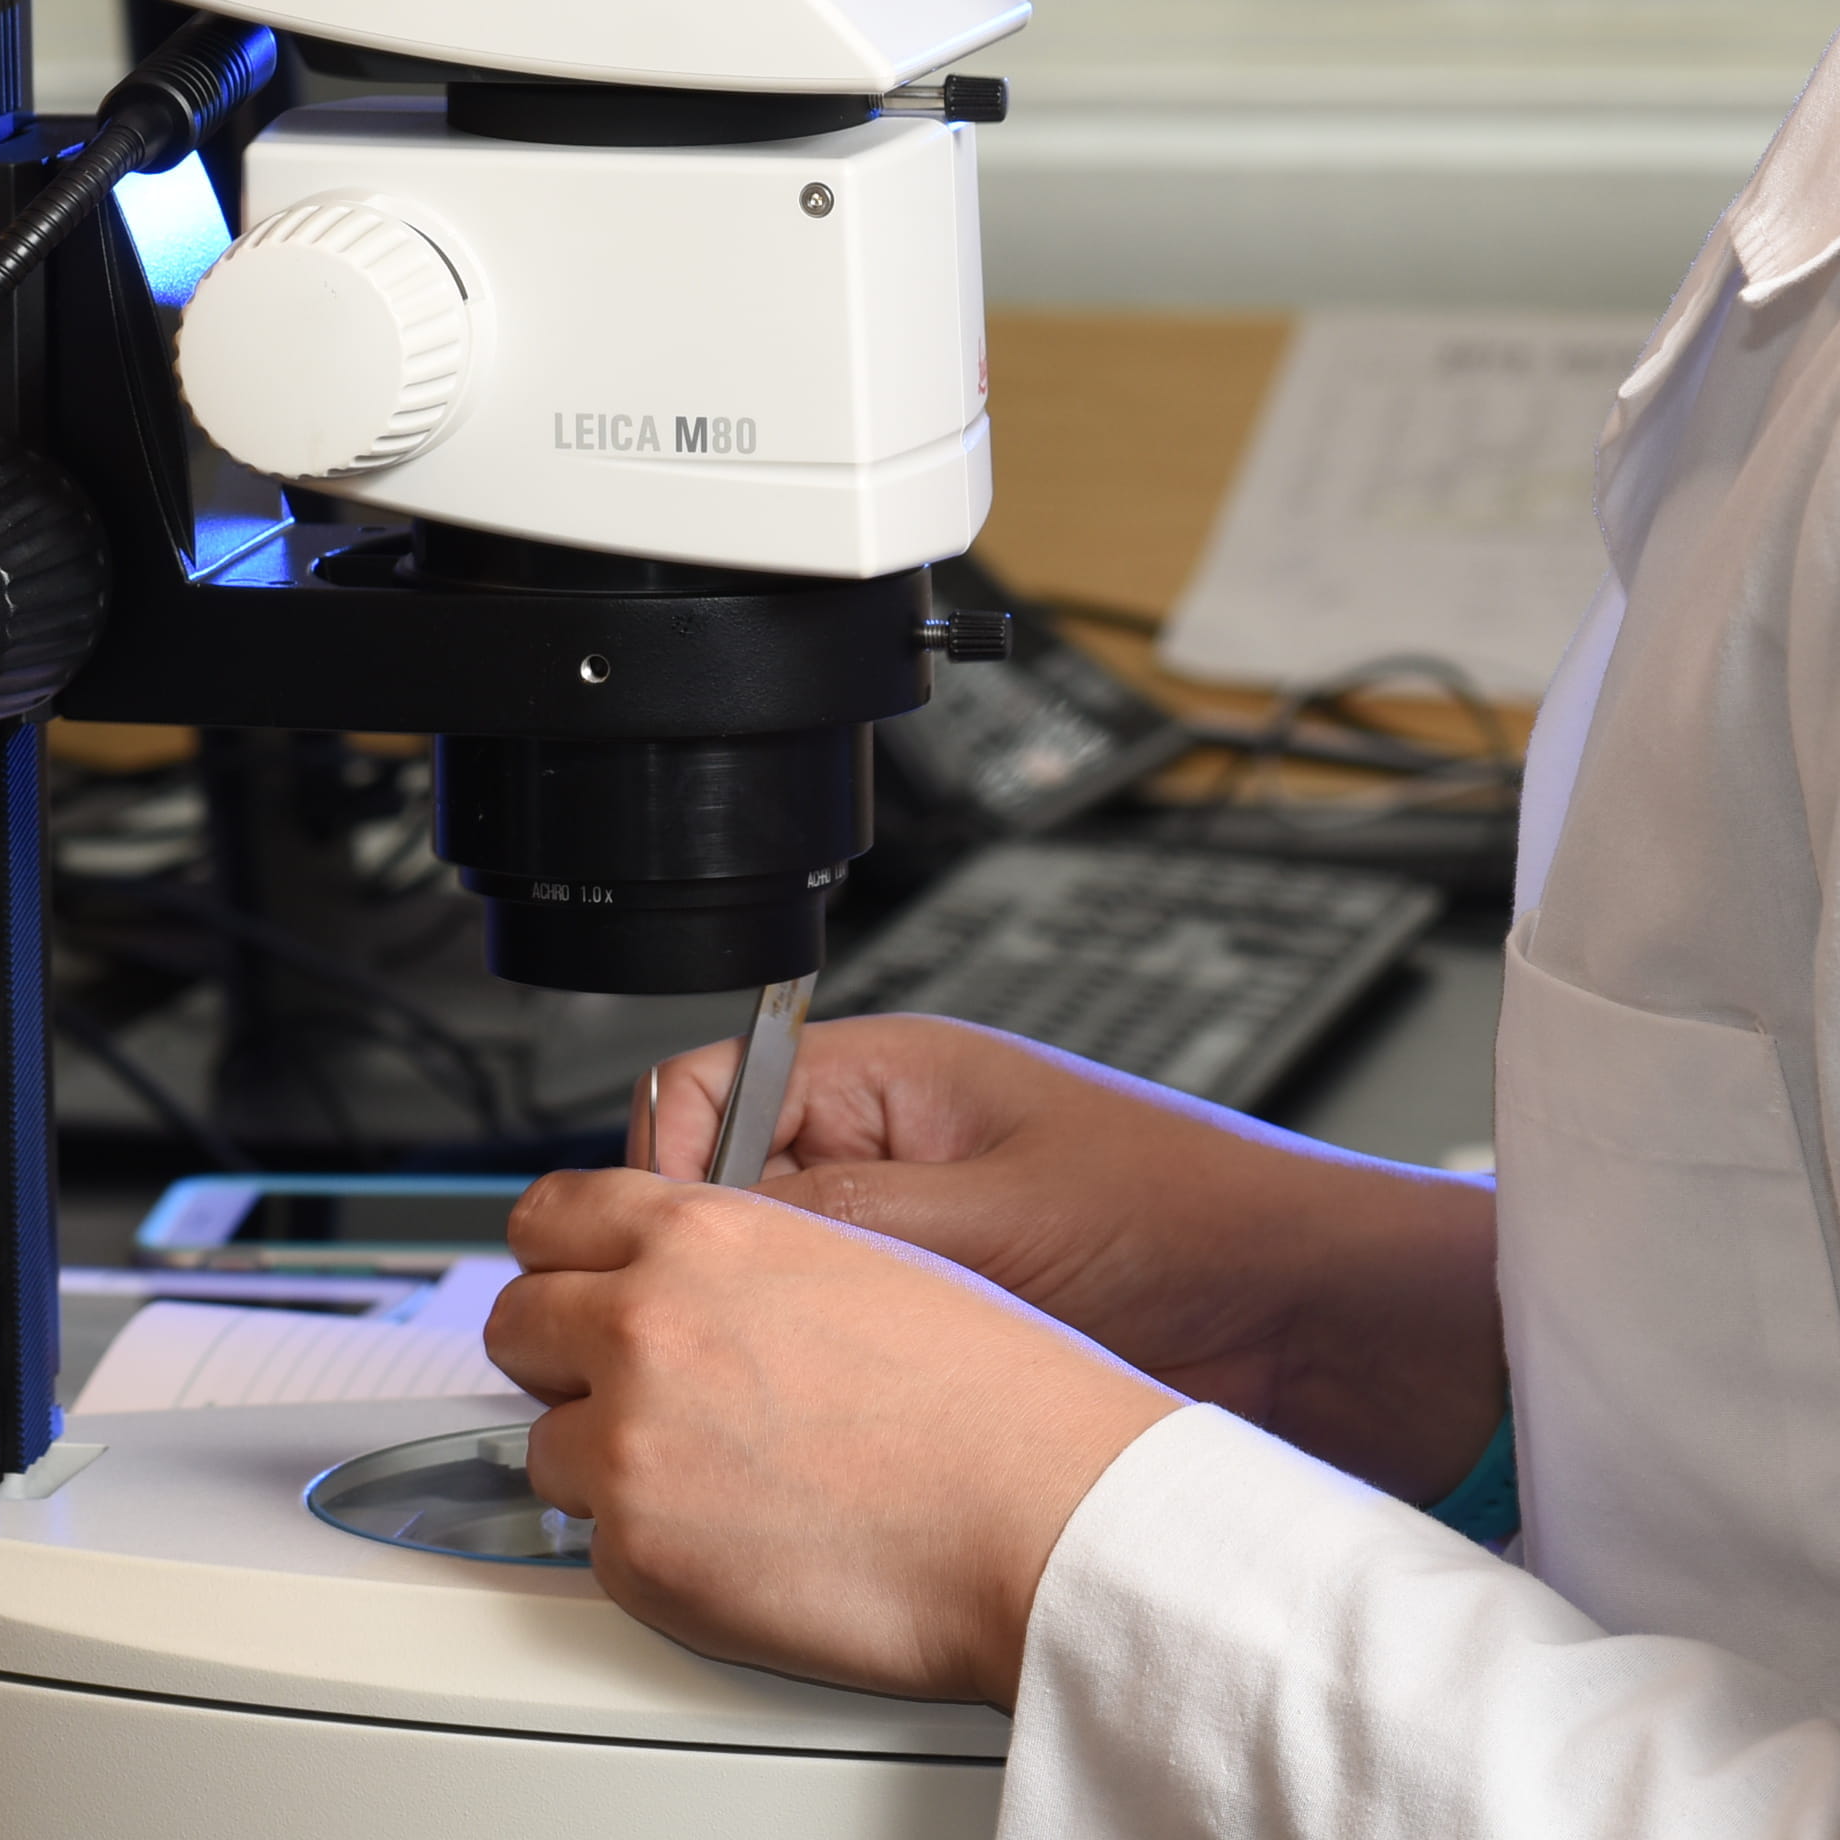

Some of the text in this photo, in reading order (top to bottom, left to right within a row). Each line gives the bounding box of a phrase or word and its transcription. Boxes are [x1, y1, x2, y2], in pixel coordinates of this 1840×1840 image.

[554, 412, 757, 455] LEICA M80
[532, 881, 570, 901] ACHRO
